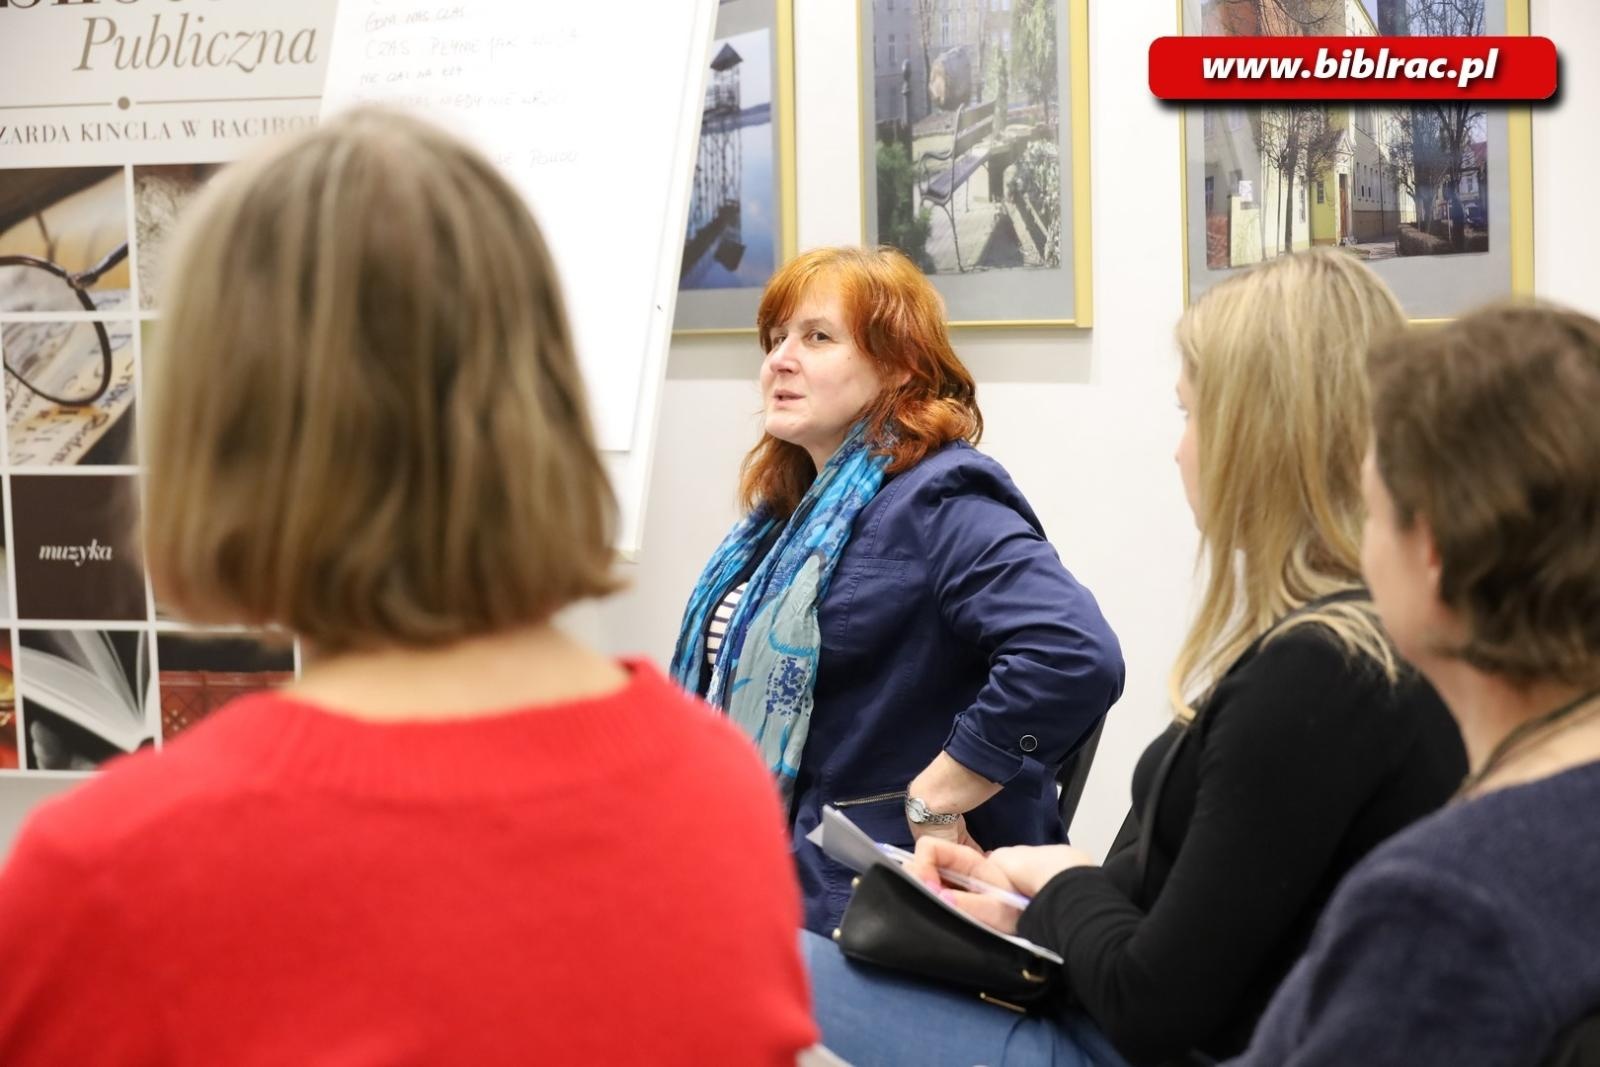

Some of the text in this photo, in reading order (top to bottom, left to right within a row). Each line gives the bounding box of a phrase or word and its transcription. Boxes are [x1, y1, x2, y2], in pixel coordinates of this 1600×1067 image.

[72, 12, 318, 73] Publiczna
[81, 121, 171, 142] KINCLA
[181, 119, 200, 137] W
[38, 538, 113, 567] muzyka
